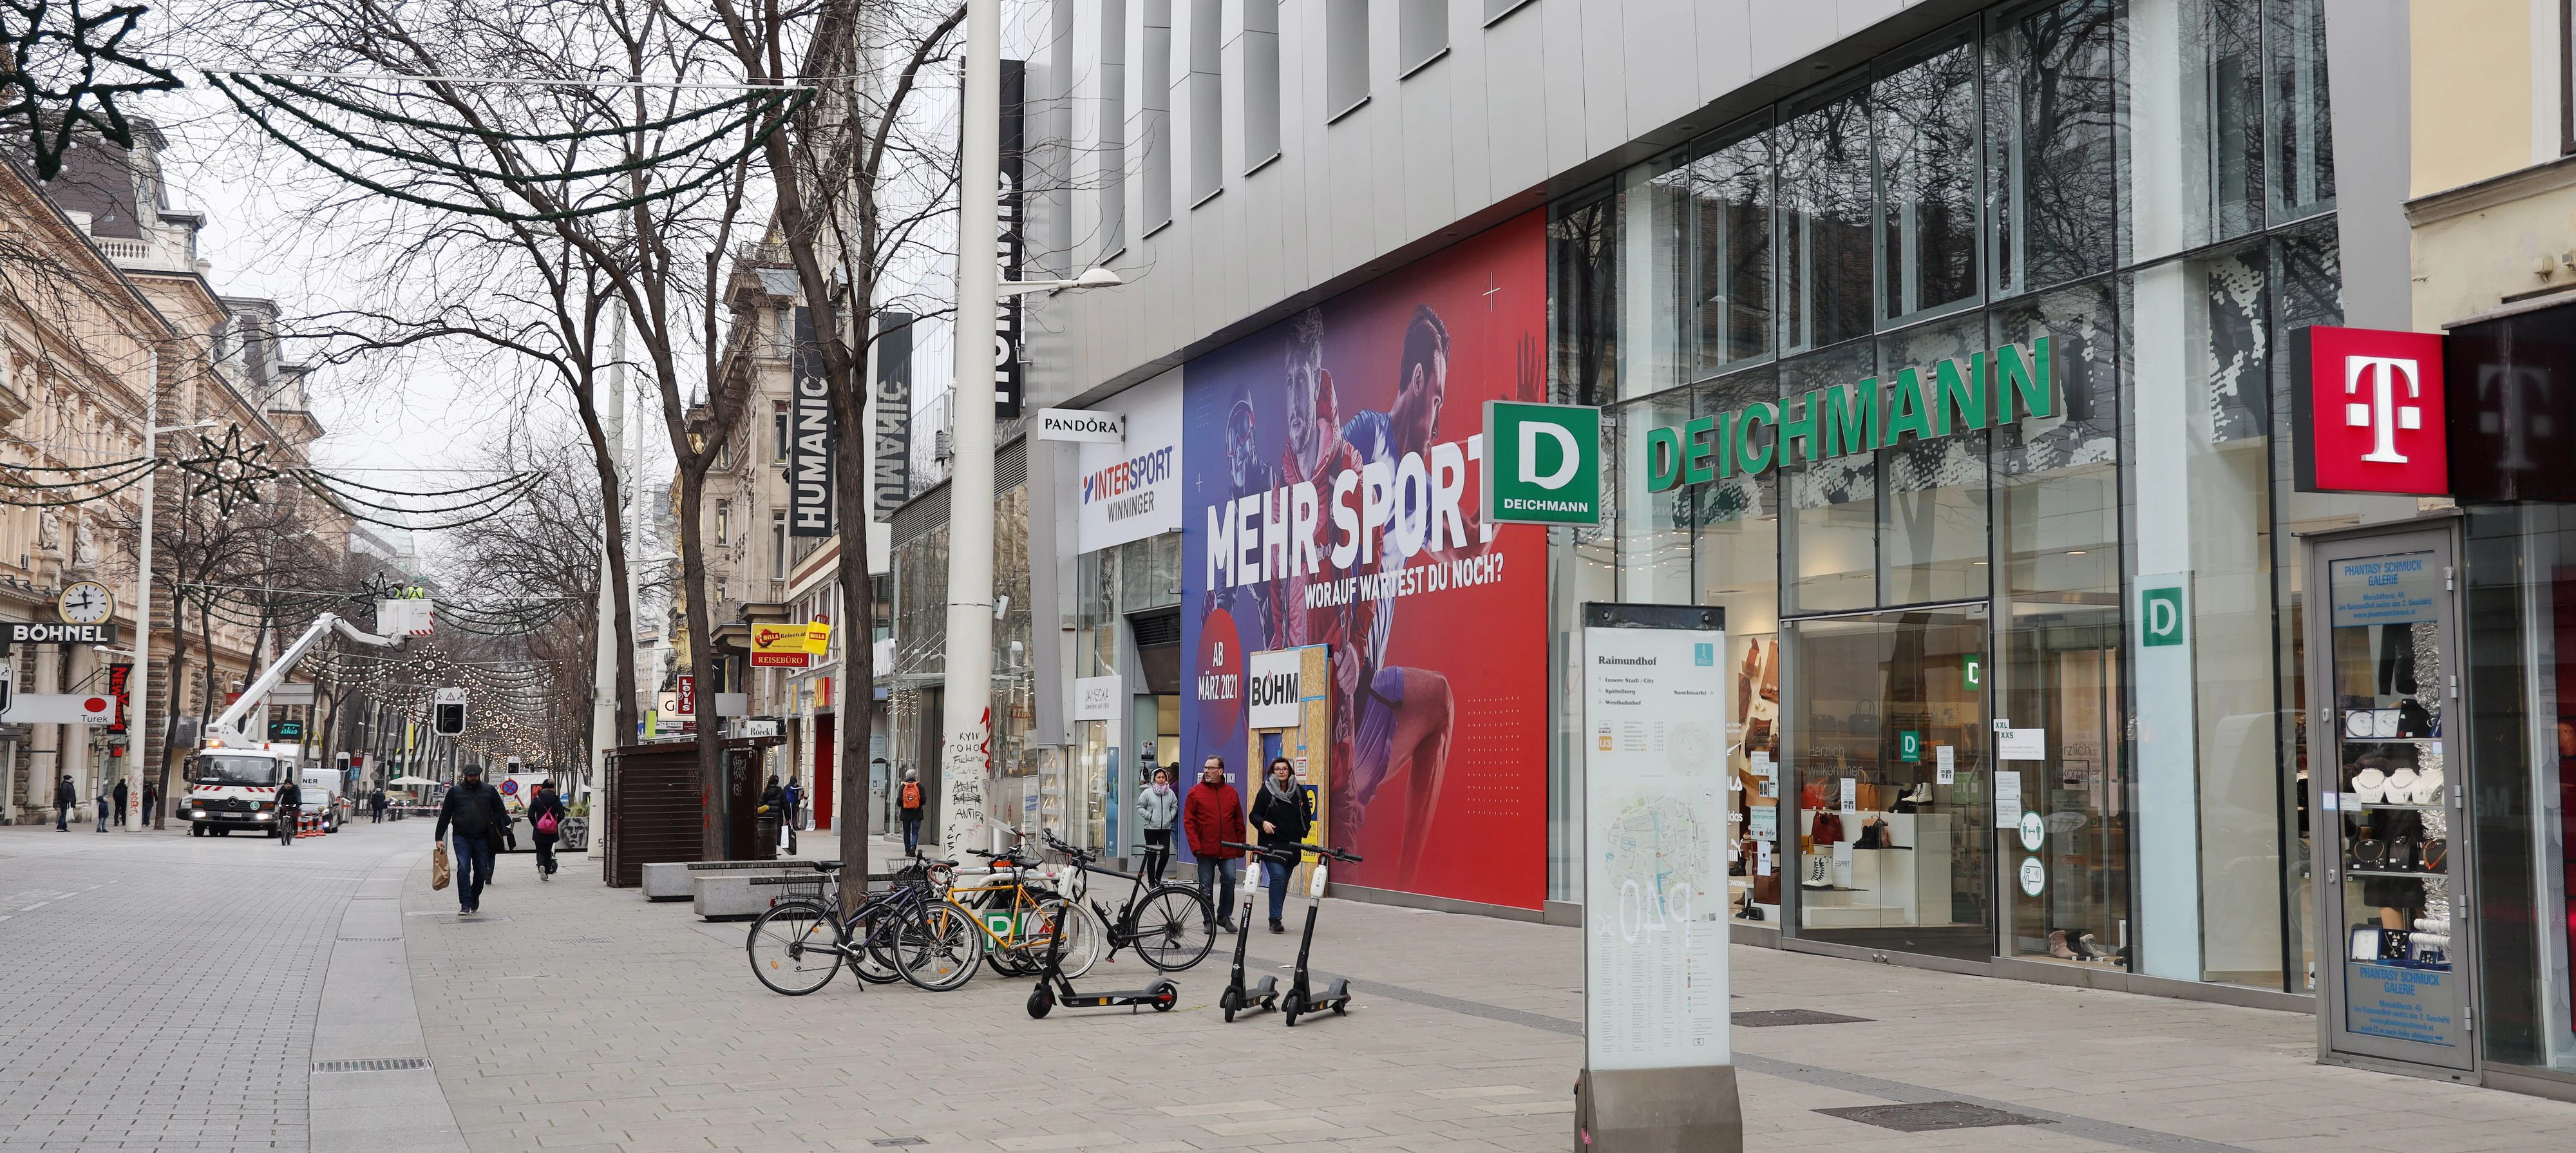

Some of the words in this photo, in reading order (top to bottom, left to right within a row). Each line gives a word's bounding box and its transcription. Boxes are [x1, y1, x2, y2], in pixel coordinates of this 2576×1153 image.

[1647, 334, 2059, 493] DEICHMANN
[2345, 355, 2421, 464] T
[1045, 417, 1118, 434] PANDORA
[797, 377, 828, 528] HUMANIC
[1519, 421, 1580, 490] D
[1094, 446, 1173, 502] INTERSPORT
[1108, 490, 1155, 523] WINNINGER
[1504, 498, 1589, 513] DEICHMANN
[1206, 481, 1320, 591] MEHR
[2345, 564, 2382, 576] PHANTASY
[2385, 560, 2421, 573] SCHMUCK
[1304, 580, 1357, 609] WORAUF
[1359, 566, 1425, 602] WARTEST
[1428, 563, 1448, 591] DU
[1452, 552, 1504, 589] NOCH?
[2368, 574, 2398, 586] GALERIE
[2150, 598, 2176, 635] D
[14, 624, 108, 642] BÖHNEL
[1212, 642, 1224, 667] AB
[1598, 656, 1657, 666] Raimundhof
[1197, 672, 1220, 701] MÄRZ
[1221, 673, 1238, 700] 2021
[1251, 670, 1298, 707] BÖHM
[751, 725, 773, 736] Roeckl
[1600, 739, 1611, 748] U3
[1808, 745, 1844, 757] Herzlich
[1905, 736, 1916, 753] D
[1808, 763, 1864, 776] willkommen
[1728, 810, 1743, 822] idas
[2360, 967, 2398, 981] PHANTASY
[2401, 971, 2440, 986] SCHMUCK
[2384, 982, 2415, 996] GALERIE
